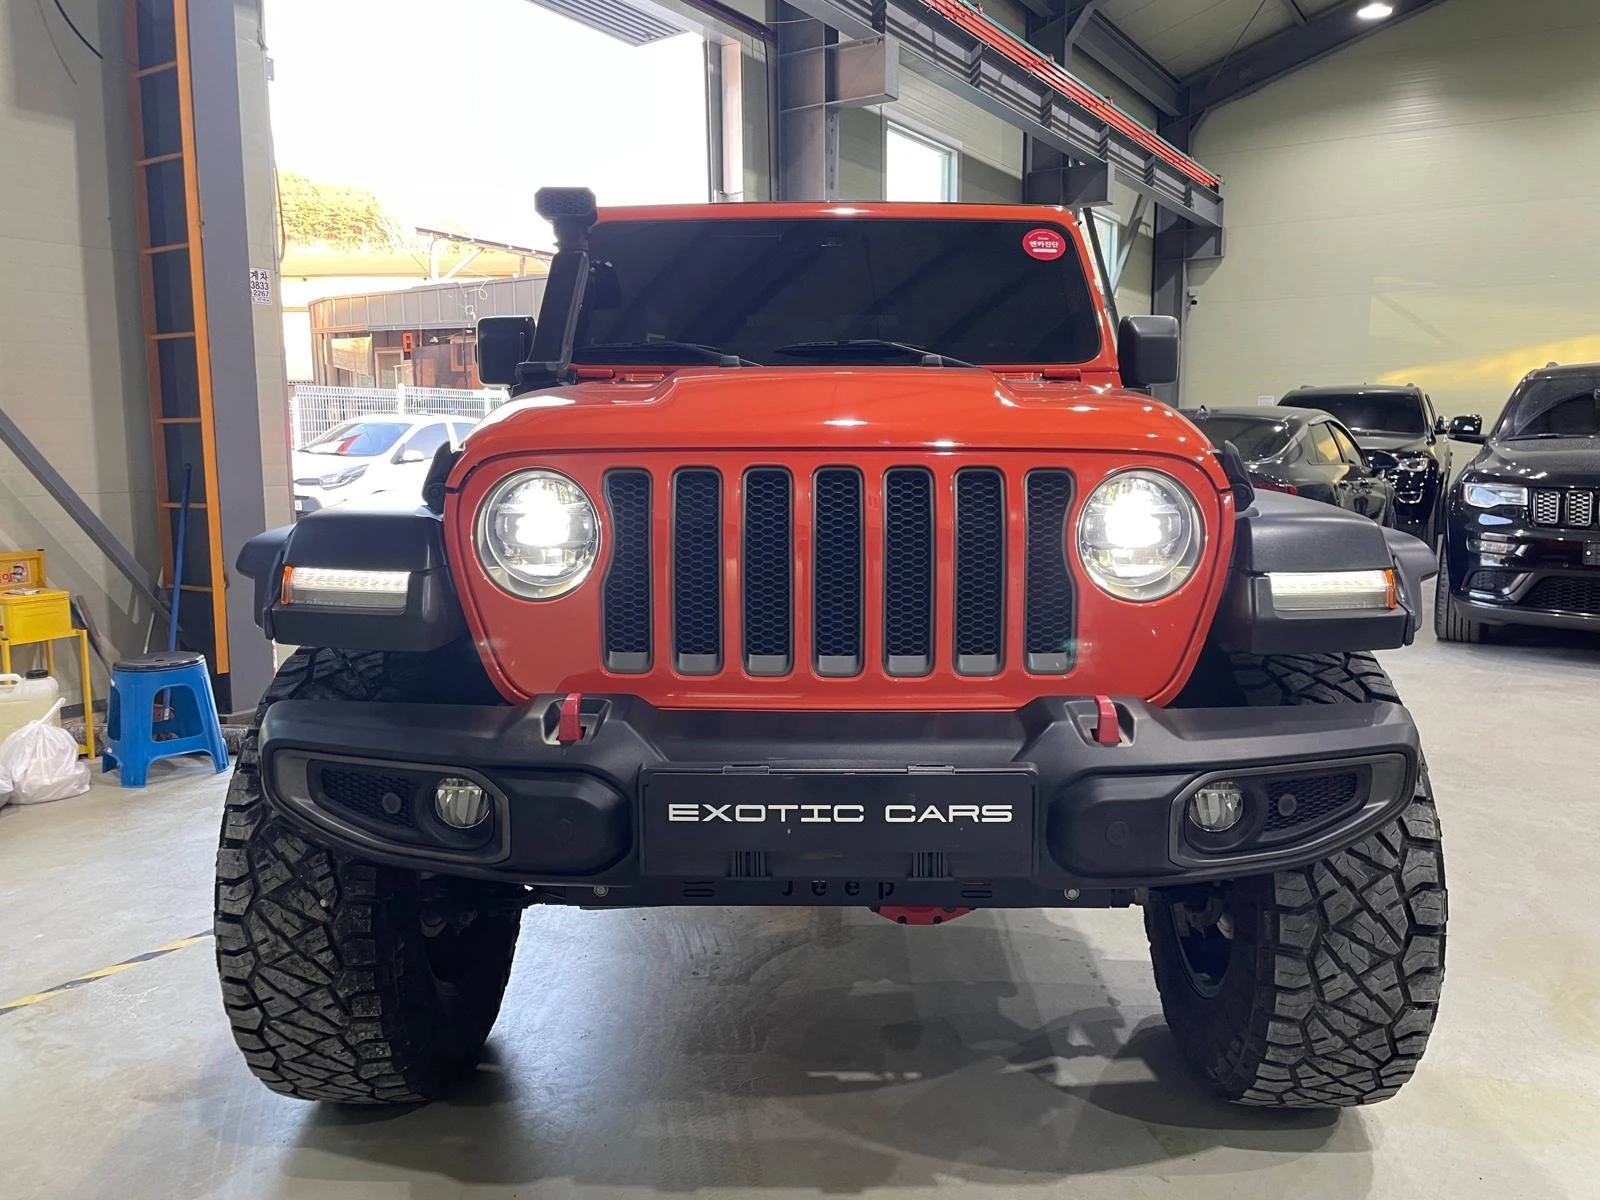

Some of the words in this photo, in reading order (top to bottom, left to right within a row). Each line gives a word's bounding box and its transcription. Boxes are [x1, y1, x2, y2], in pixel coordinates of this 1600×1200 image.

[250, 281, 269, 290] 3833
[668, 803, 865, 823] EXOTIC
[884, 803, 1013, 823] CARS
[780, 879, 896, 901] Jeep
